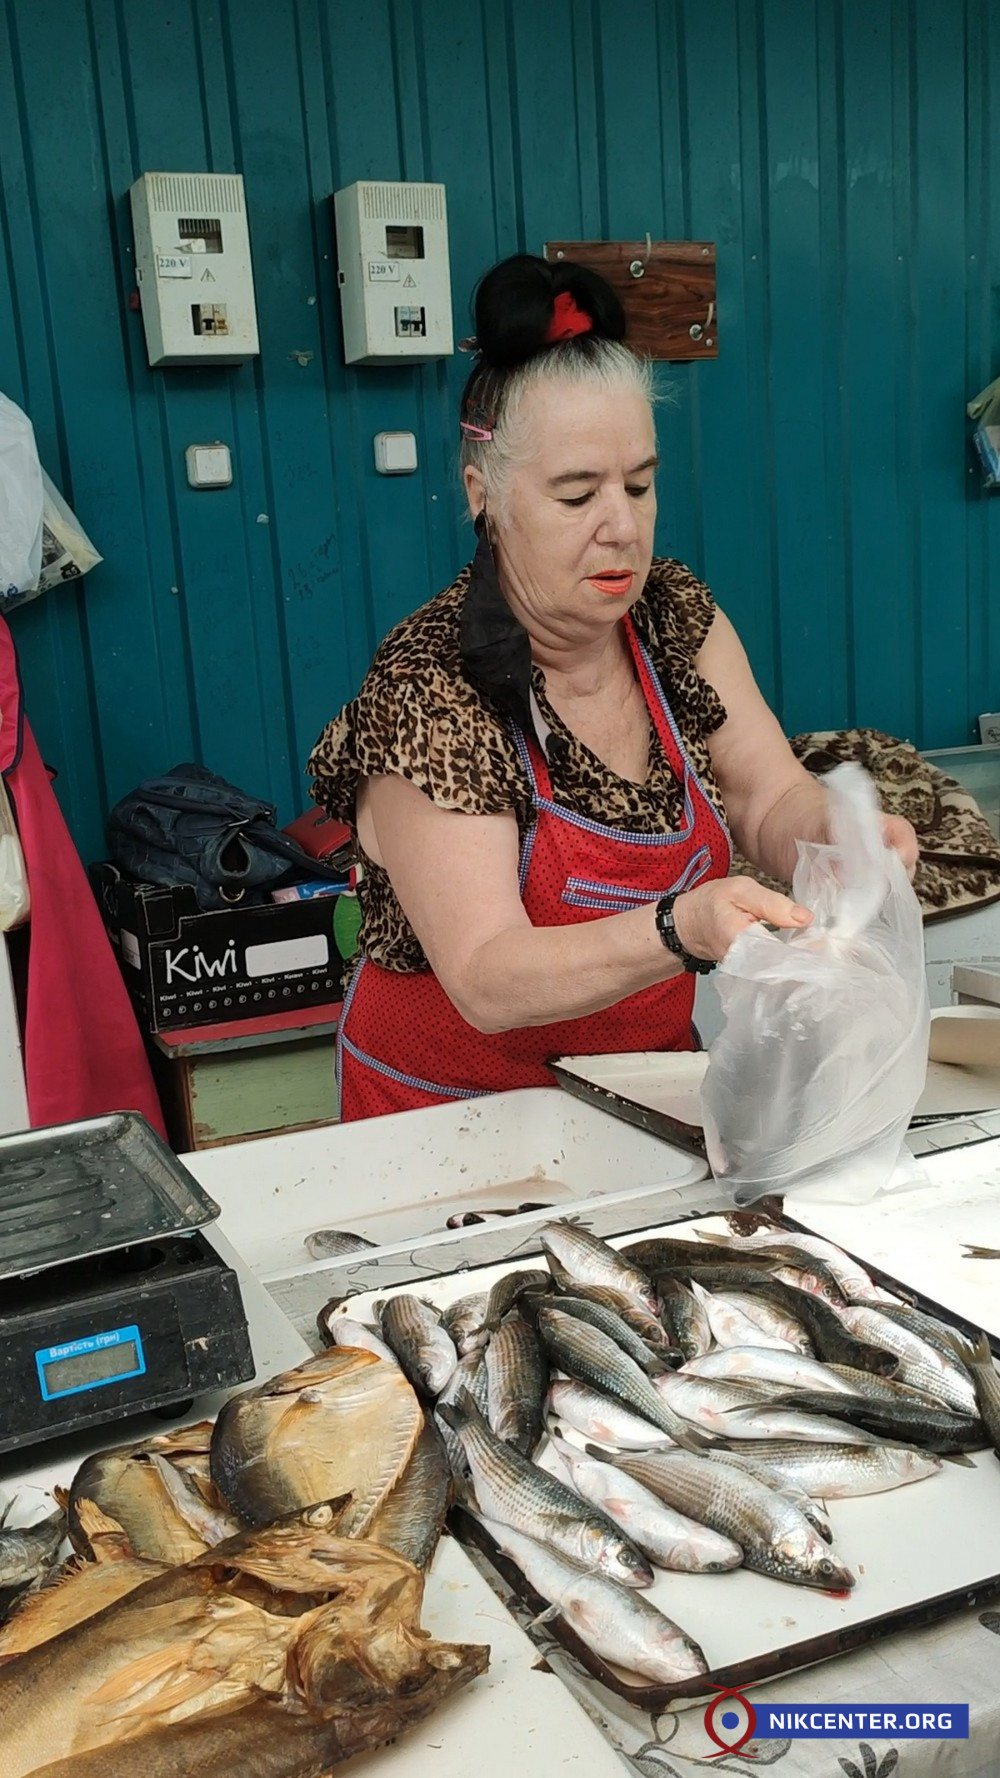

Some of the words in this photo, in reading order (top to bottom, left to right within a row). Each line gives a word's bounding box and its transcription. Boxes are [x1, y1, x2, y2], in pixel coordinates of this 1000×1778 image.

[159, 258, 176, 268] 220
[179, 258, 187, 268] V
[371, 265, 386, 274] 220
[388, 265, 395, 274] V
[165, 939, 238, 984] Kiwi
[49, 1340, 94, 1358] Вартість
